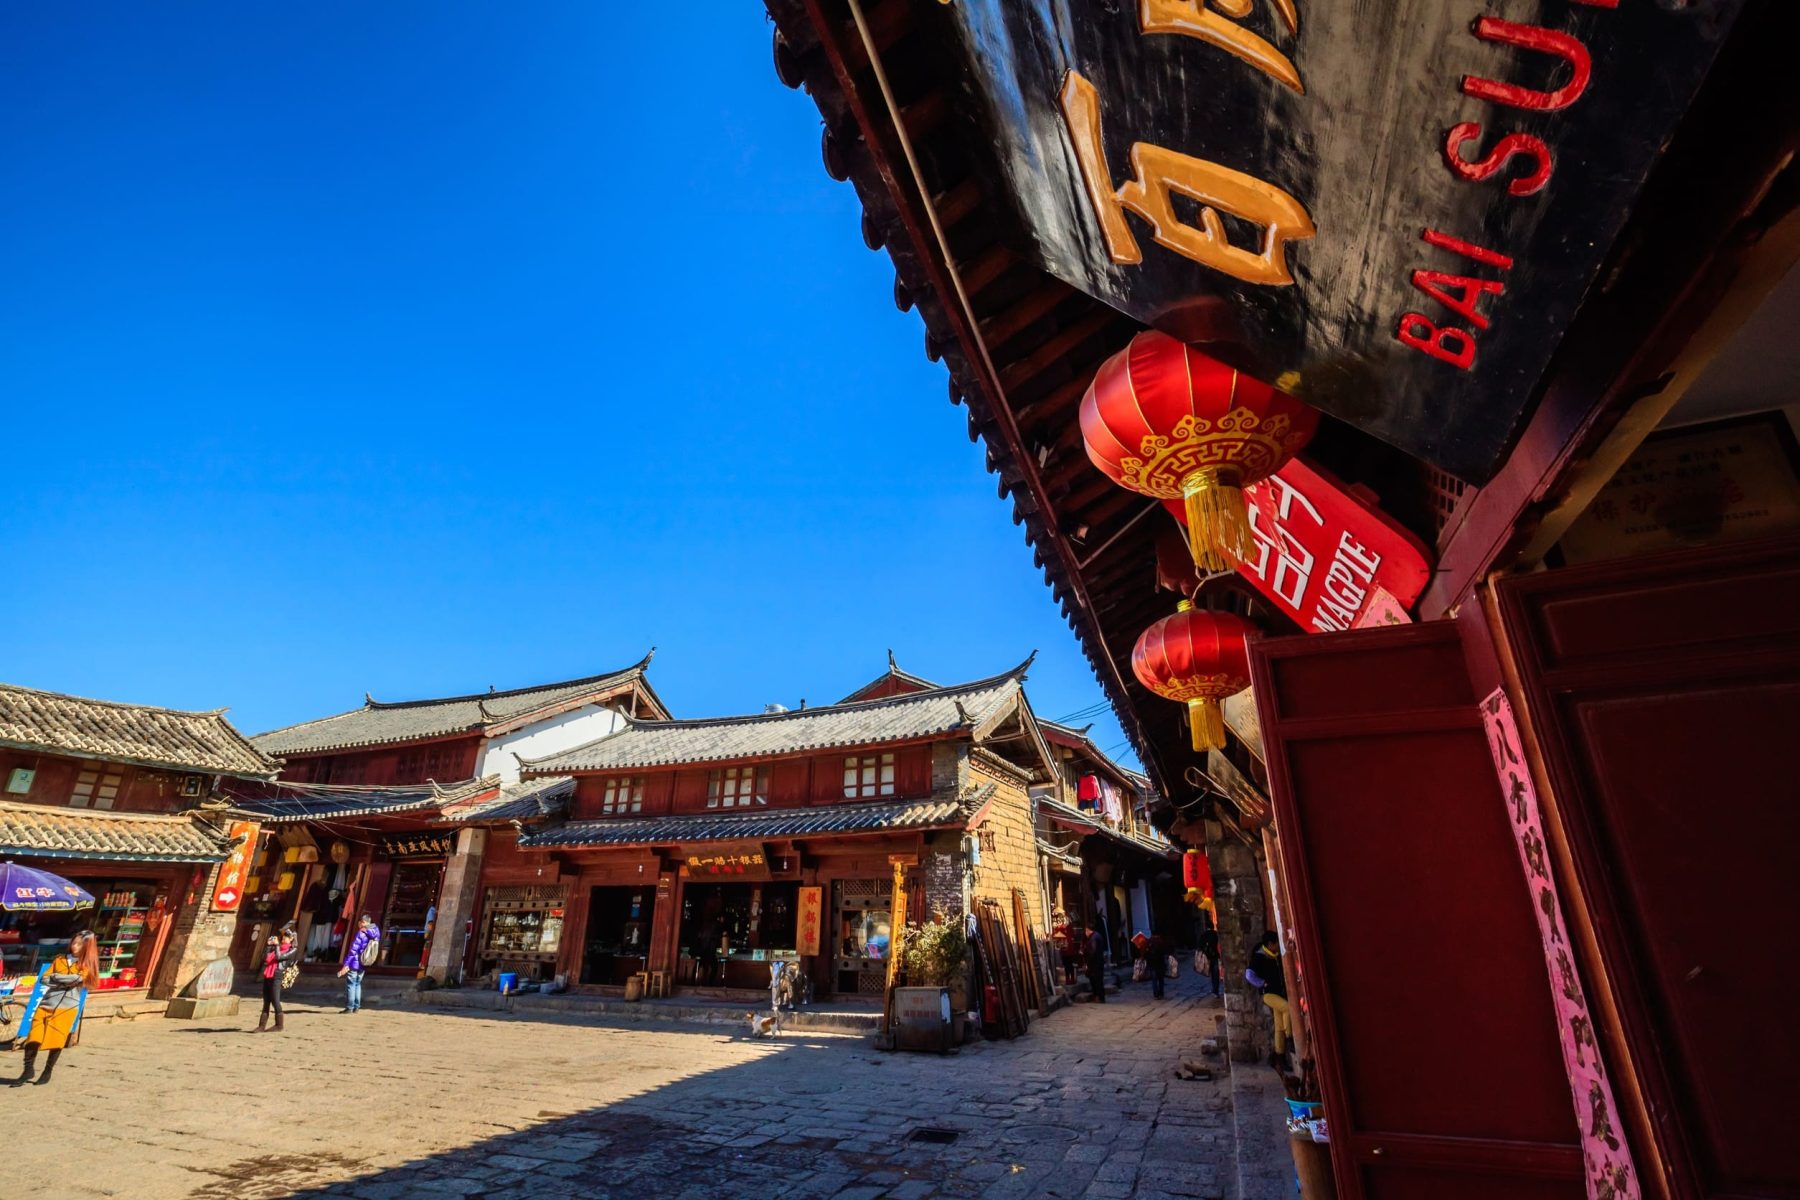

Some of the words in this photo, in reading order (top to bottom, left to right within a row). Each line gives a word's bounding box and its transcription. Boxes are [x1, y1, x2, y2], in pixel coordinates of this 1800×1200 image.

[1445, 0, 1619, 198] SU
[1397, 228, 1514, 370] BAI
[1312, 530, 1381, 633] MAGPIE
[16, 886, 56, 899] 红牛
